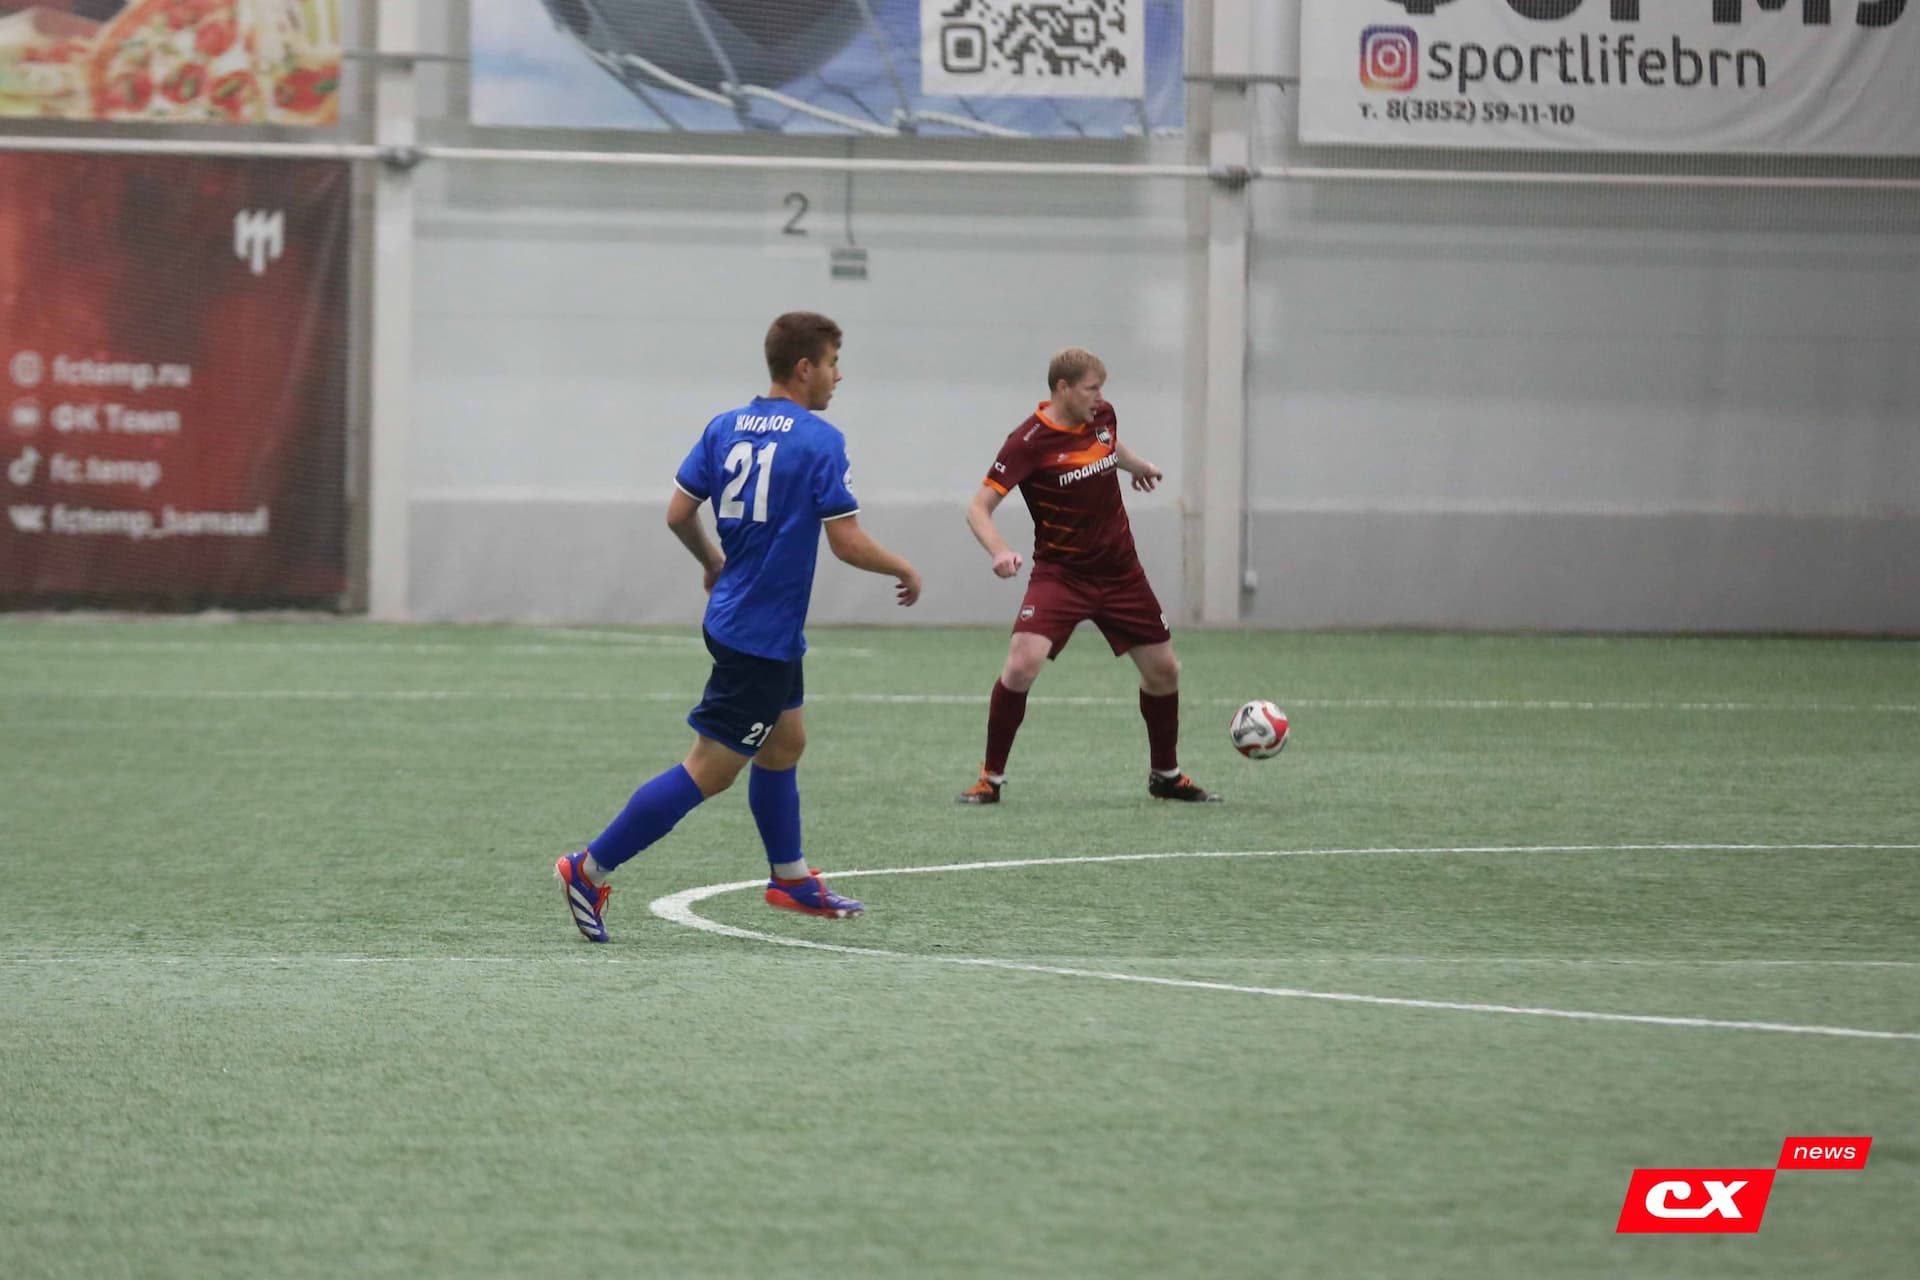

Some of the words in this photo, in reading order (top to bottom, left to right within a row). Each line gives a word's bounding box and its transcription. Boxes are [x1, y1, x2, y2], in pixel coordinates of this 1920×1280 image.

[1427, 33, 1767, 94] sportlifebrn
[1386, 98, 1476, 124] 8(3852)
[1481, 101, 1575, 124] 59-11-10
[782, 192, 809, 235] 2
[52, 356, 192, 391] fctemp.ru
[50, 403, 100, 433] ФК
[719, 441, 778, 523] 21
[50, 503, 270, 541] fctemp_barnaul
[741, 722, 773, 748] 21
